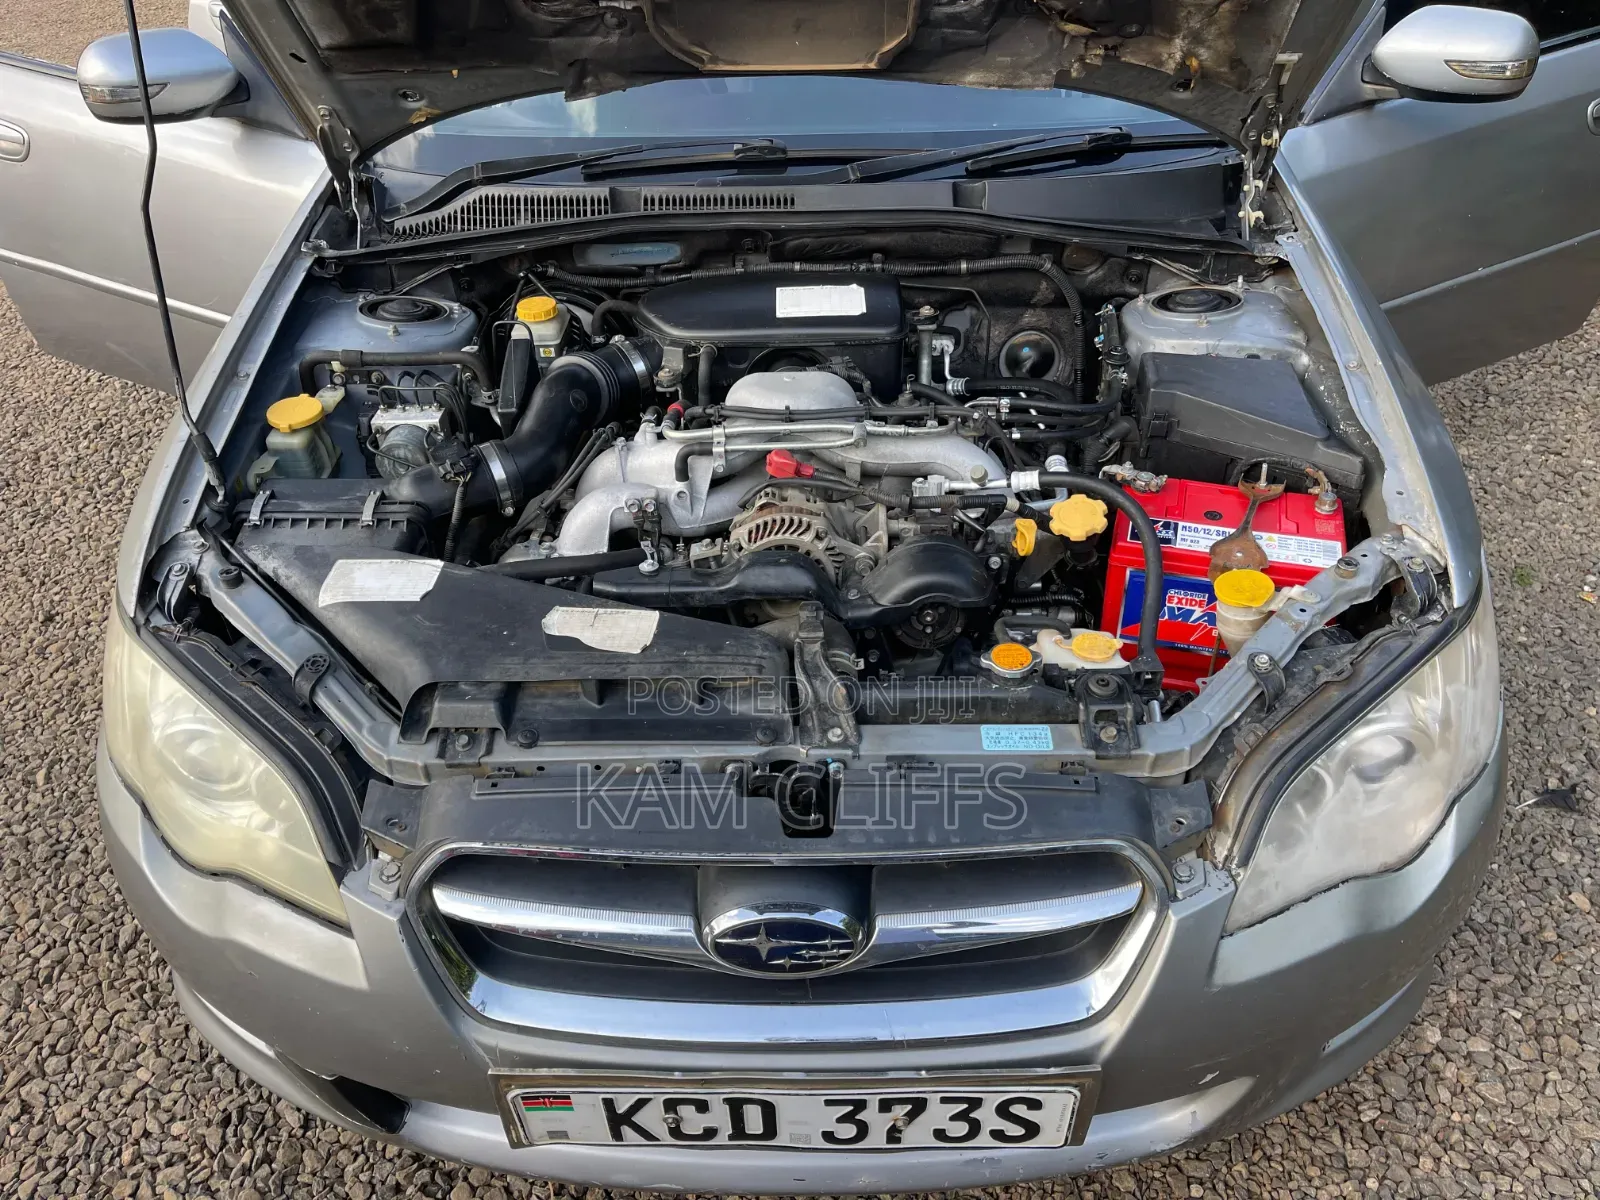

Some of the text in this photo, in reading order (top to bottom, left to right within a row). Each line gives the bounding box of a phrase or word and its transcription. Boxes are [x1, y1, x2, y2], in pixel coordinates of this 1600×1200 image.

[1166, 594, 1207, 610] EXIDE
[1168, 589, 1208, 599] CHLORIDE
[601, 1096, 778, 1142] KCD
[820, 1095, 1043, 1145] 373S
